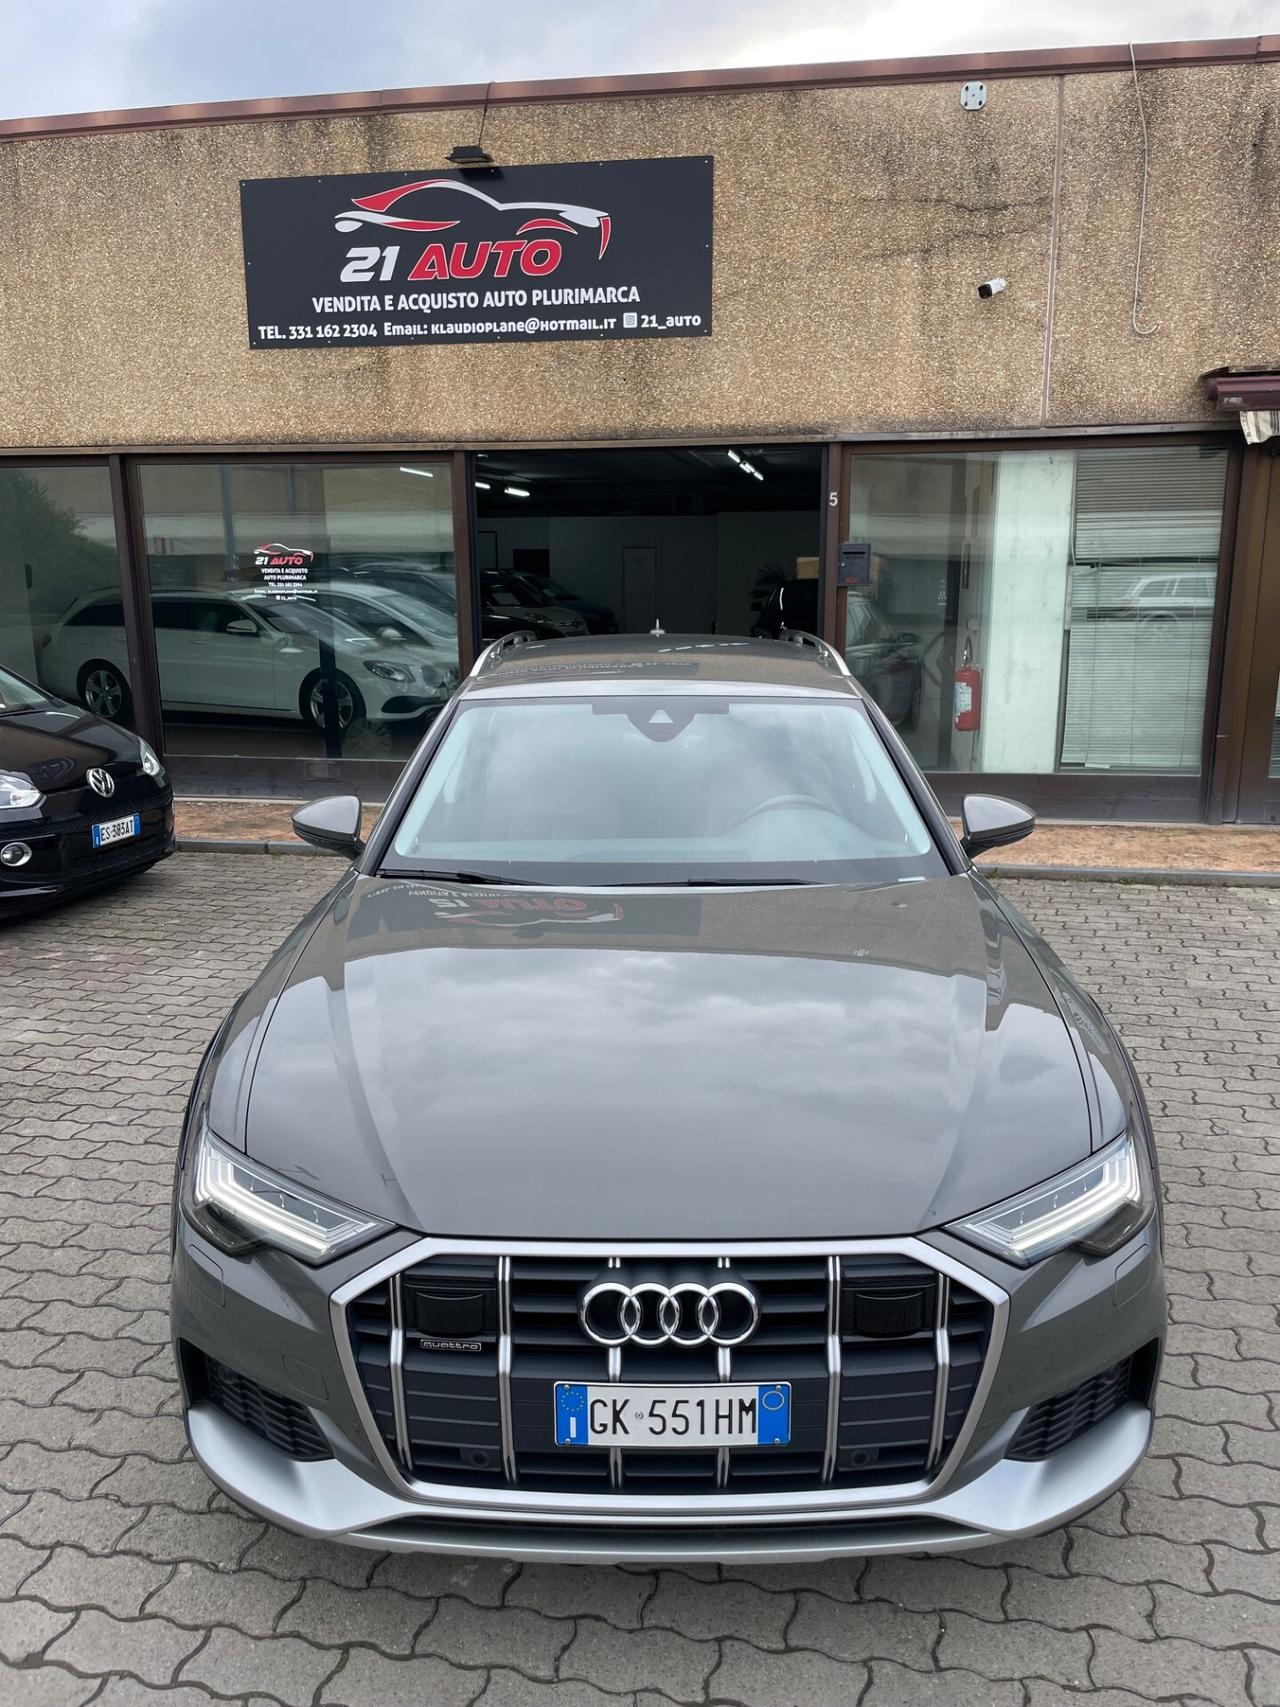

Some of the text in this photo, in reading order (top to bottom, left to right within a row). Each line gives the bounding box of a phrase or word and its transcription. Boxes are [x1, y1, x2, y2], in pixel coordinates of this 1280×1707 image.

[339, 238, 562, 283] 21 AUTO
[311, 285, 641, 314] VENDITA E ACQUISTO AUTO PLURIMARCA
[257, 325, 287, 340] TEL.
[288, 325, 314, 340] 331
[315, 324, 341, 339] 162
[342, 323, 378, 338] 2304
[828, 491, 839, 507] 5
[255, 556, 303, 565] 21 AUTO
[422, 1340, 479, 1350] quattro
[590, 1398, 630, 1435] GK
[648, 1398, 757, 1435] 551HM
